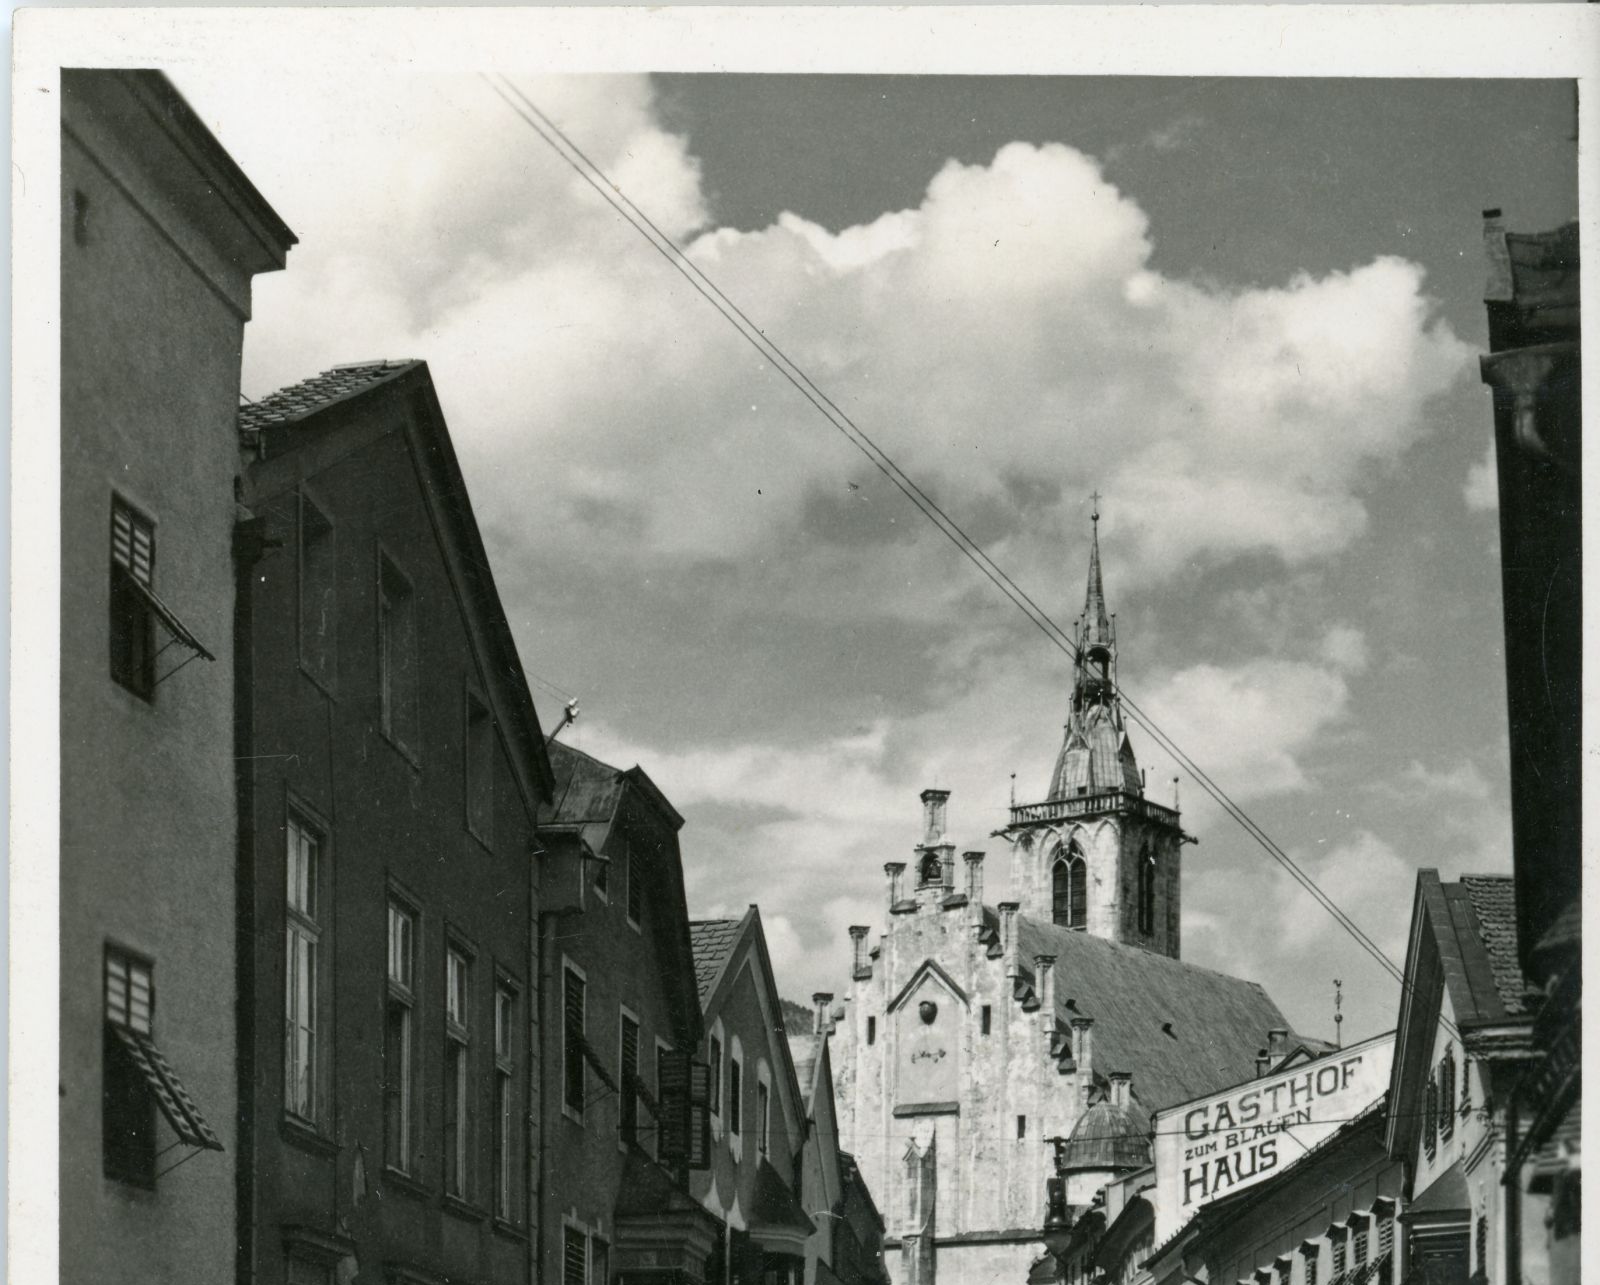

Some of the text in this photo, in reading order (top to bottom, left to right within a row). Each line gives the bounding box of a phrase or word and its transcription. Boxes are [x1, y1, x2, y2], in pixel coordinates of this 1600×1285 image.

[1184, 1056, 1362, 1142] GASTHOF
[1185, 1107, 1312, 1162] ZUM BLAUEN
[1182, 1139, 1278, 1206] HAUS
